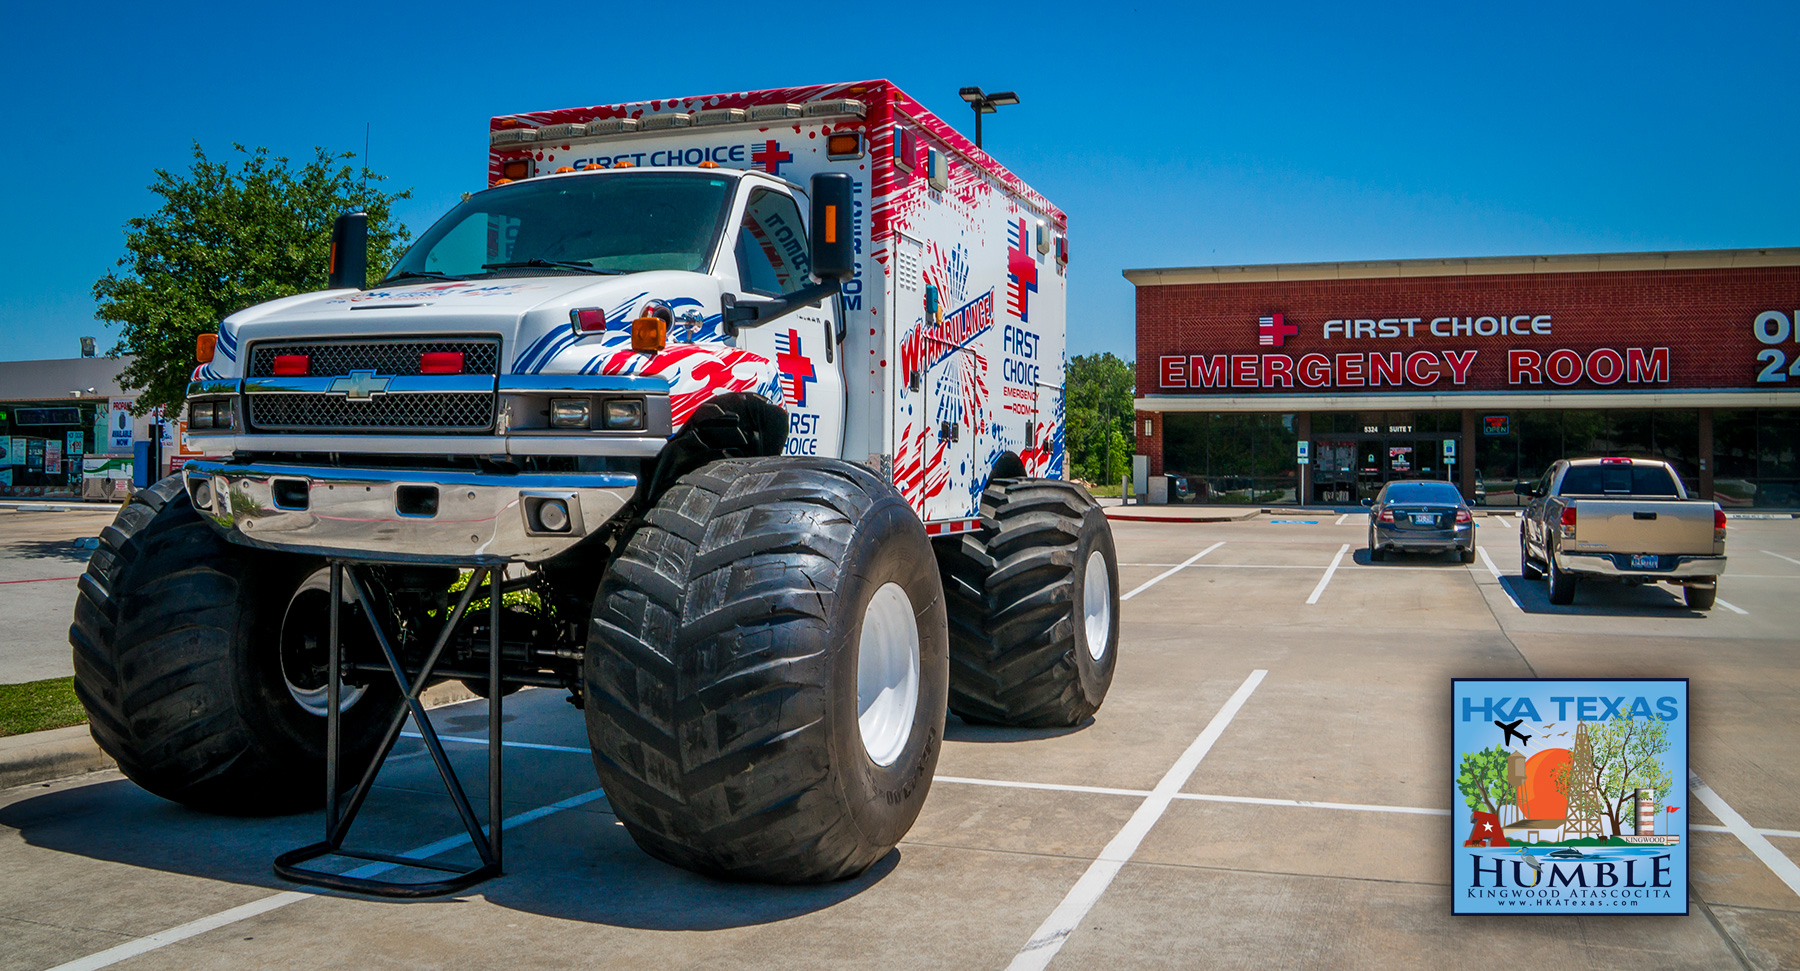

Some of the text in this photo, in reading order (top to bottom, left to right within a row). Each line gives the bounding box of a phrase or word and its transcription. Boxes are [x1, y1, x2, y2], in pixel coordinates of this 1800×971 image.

[573, 145, 745, 170] FIRST CHOICE
[1323, 315, 1552, 339] FIRST CHOICE
[1754, 310, 1800, 344] O
[1003, 324, 1040, 361] FIRST
[1003, 358, 1040, 387] CHOICE
[1159, 347, 1669, 388] EMERGENCY ROOM
[1003, 386, 1040, 401] EMERGENCY
[1012, 403, 1031, 415] ROOM
[112, 430, 132, 438] AVAILABLE
[788, 412, 820, 435] RST
[784, 437, 818, 455] HOICE
